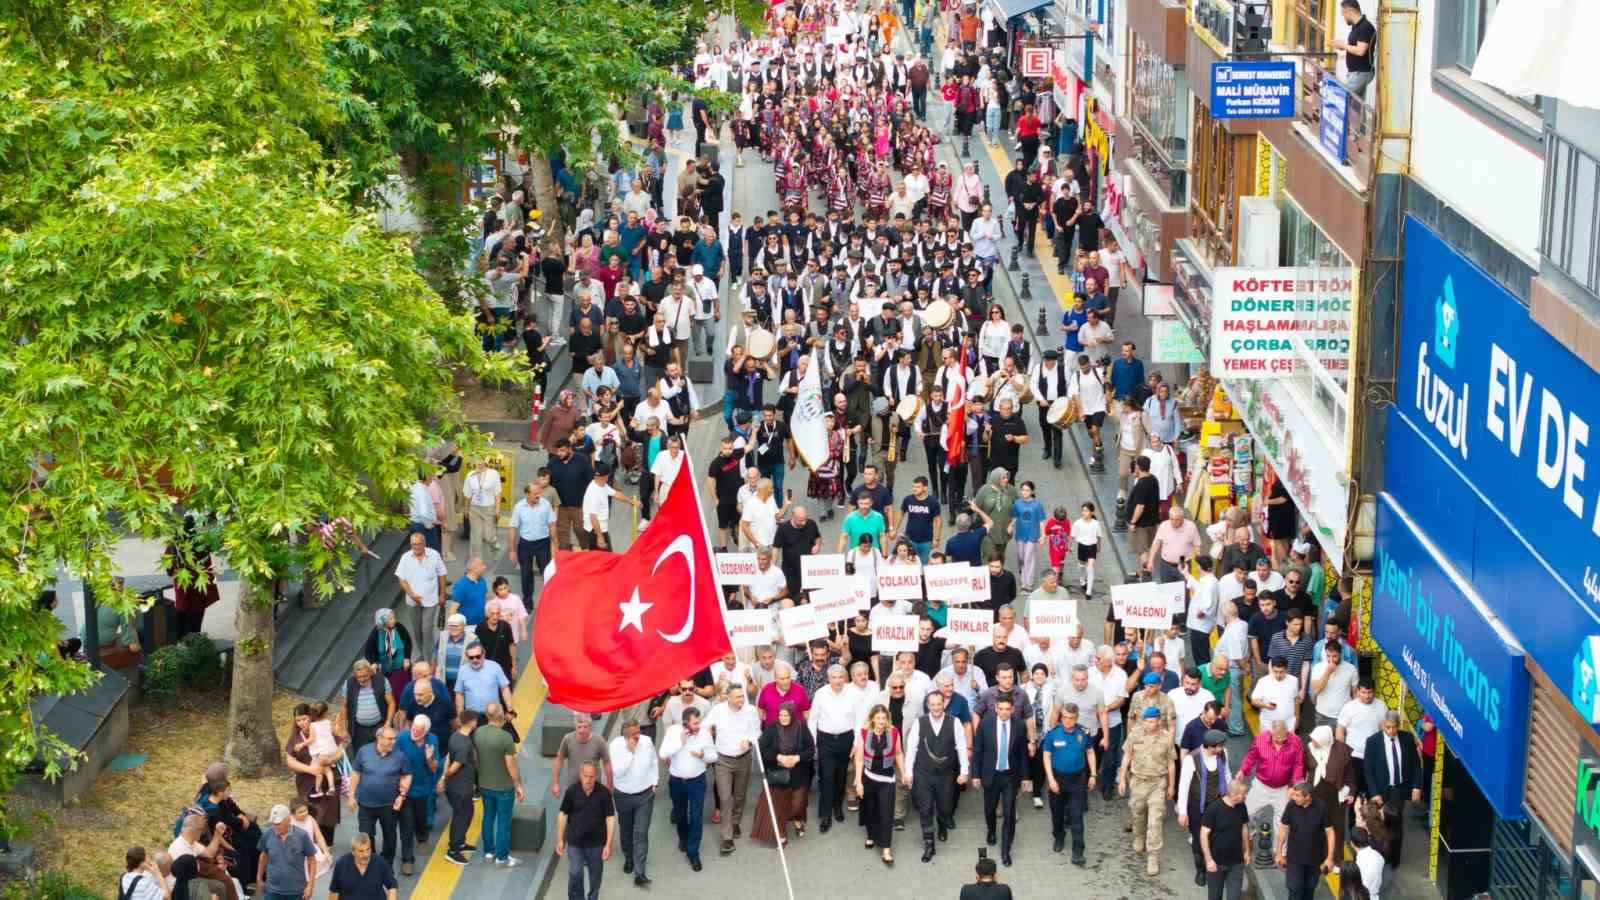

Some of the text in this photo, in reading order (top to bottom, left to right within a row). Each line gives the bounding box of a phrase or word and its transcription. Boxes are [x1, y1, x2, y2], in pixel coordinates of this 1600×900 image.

[1031, 54, 1044, 71] E
[1216, 83, 1290, 98] MALİ MÜŞAVİR
[1233, 278, 1294, 292] KÖFTE
[1231, 298, 1295, 312] DÖNER
[1223, 320, 1299, 334] HAŞLAMA
[1231, 339, 1292, 353] ÇORBA
[1223, 358, 1266, 371] YEMEK
[1416, 341, 1589, 520] fuzul EV DE
[1377, 547, 1500, 731] yeni bir finans
